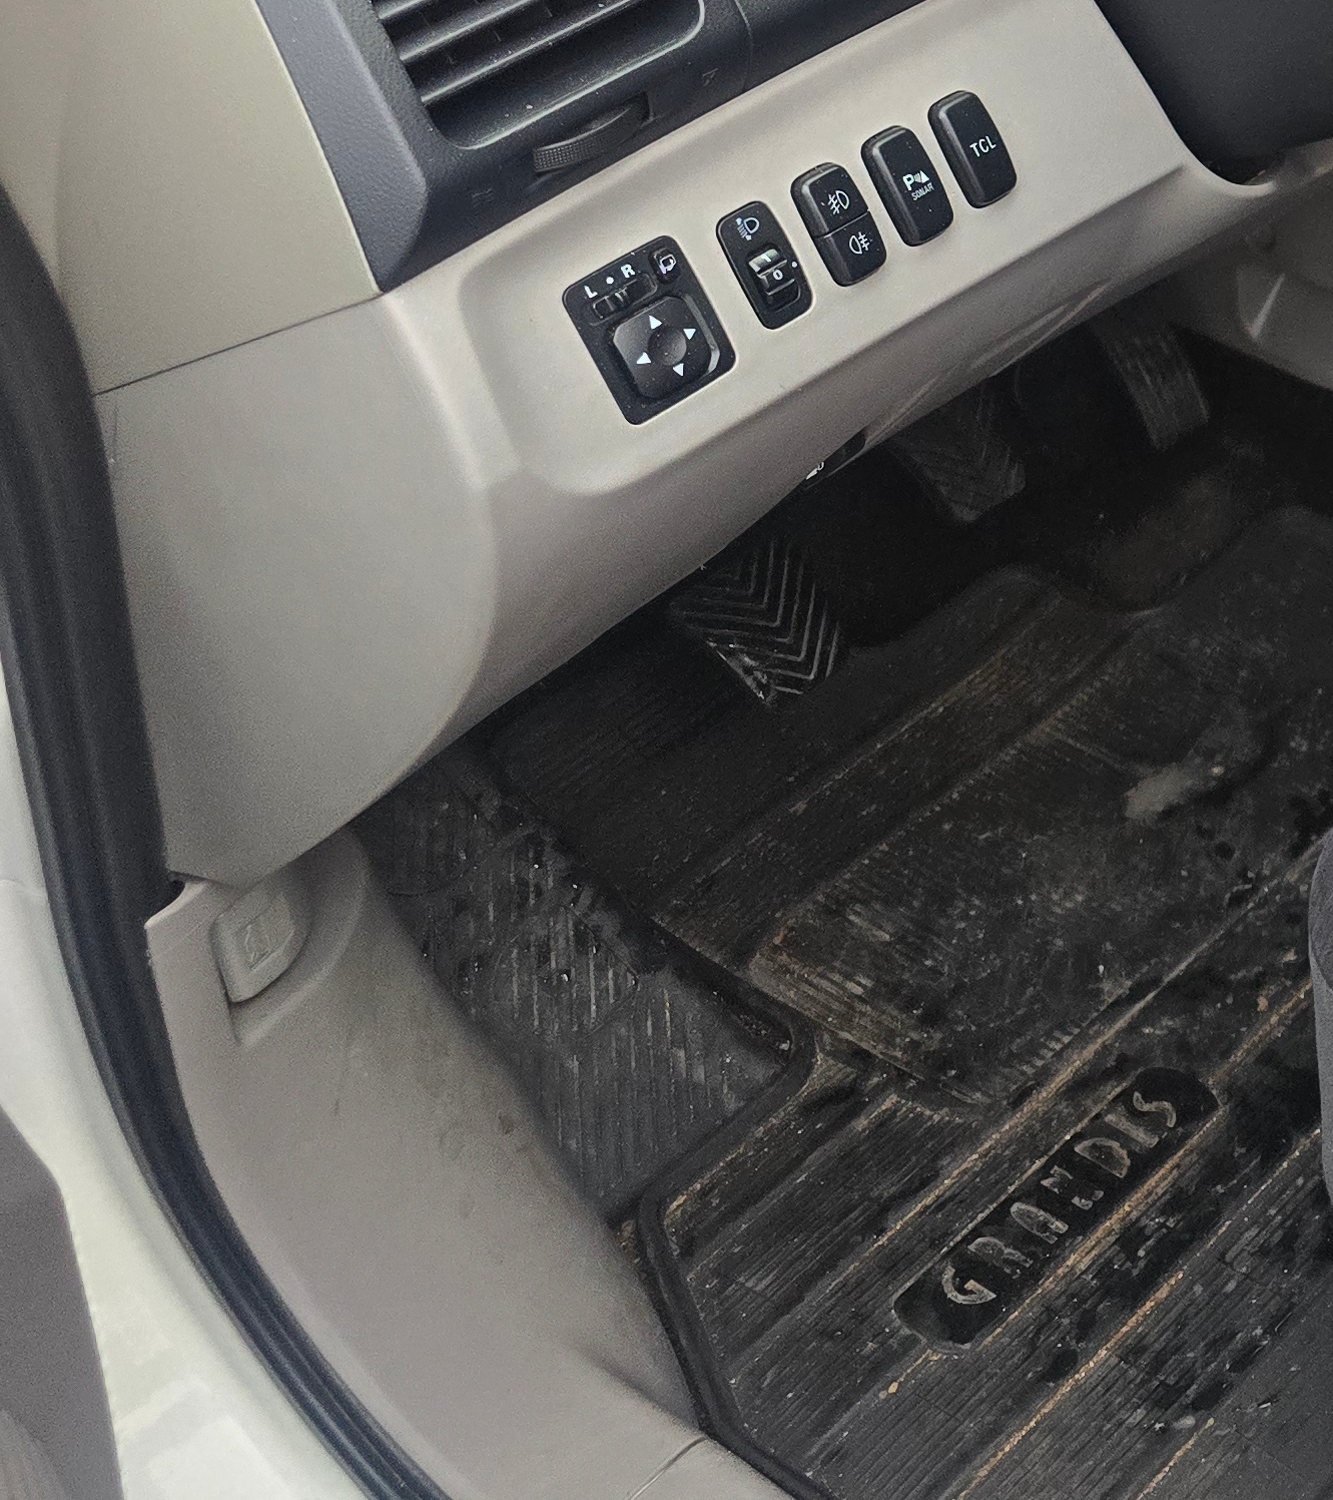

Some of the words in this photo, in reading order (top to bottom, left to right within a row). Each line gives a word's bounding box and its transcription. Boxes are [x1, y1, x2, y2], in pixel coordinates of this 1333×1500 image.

[969, 135, 997, 157] TCL
[911, 182, 935, 201] SONAR
[583, 285, 598, 299] L
[620, 263, 636, 278] R
[772, 269, 784, 280] 0
[941, 1091, 1176, 1305] GRANDIS
